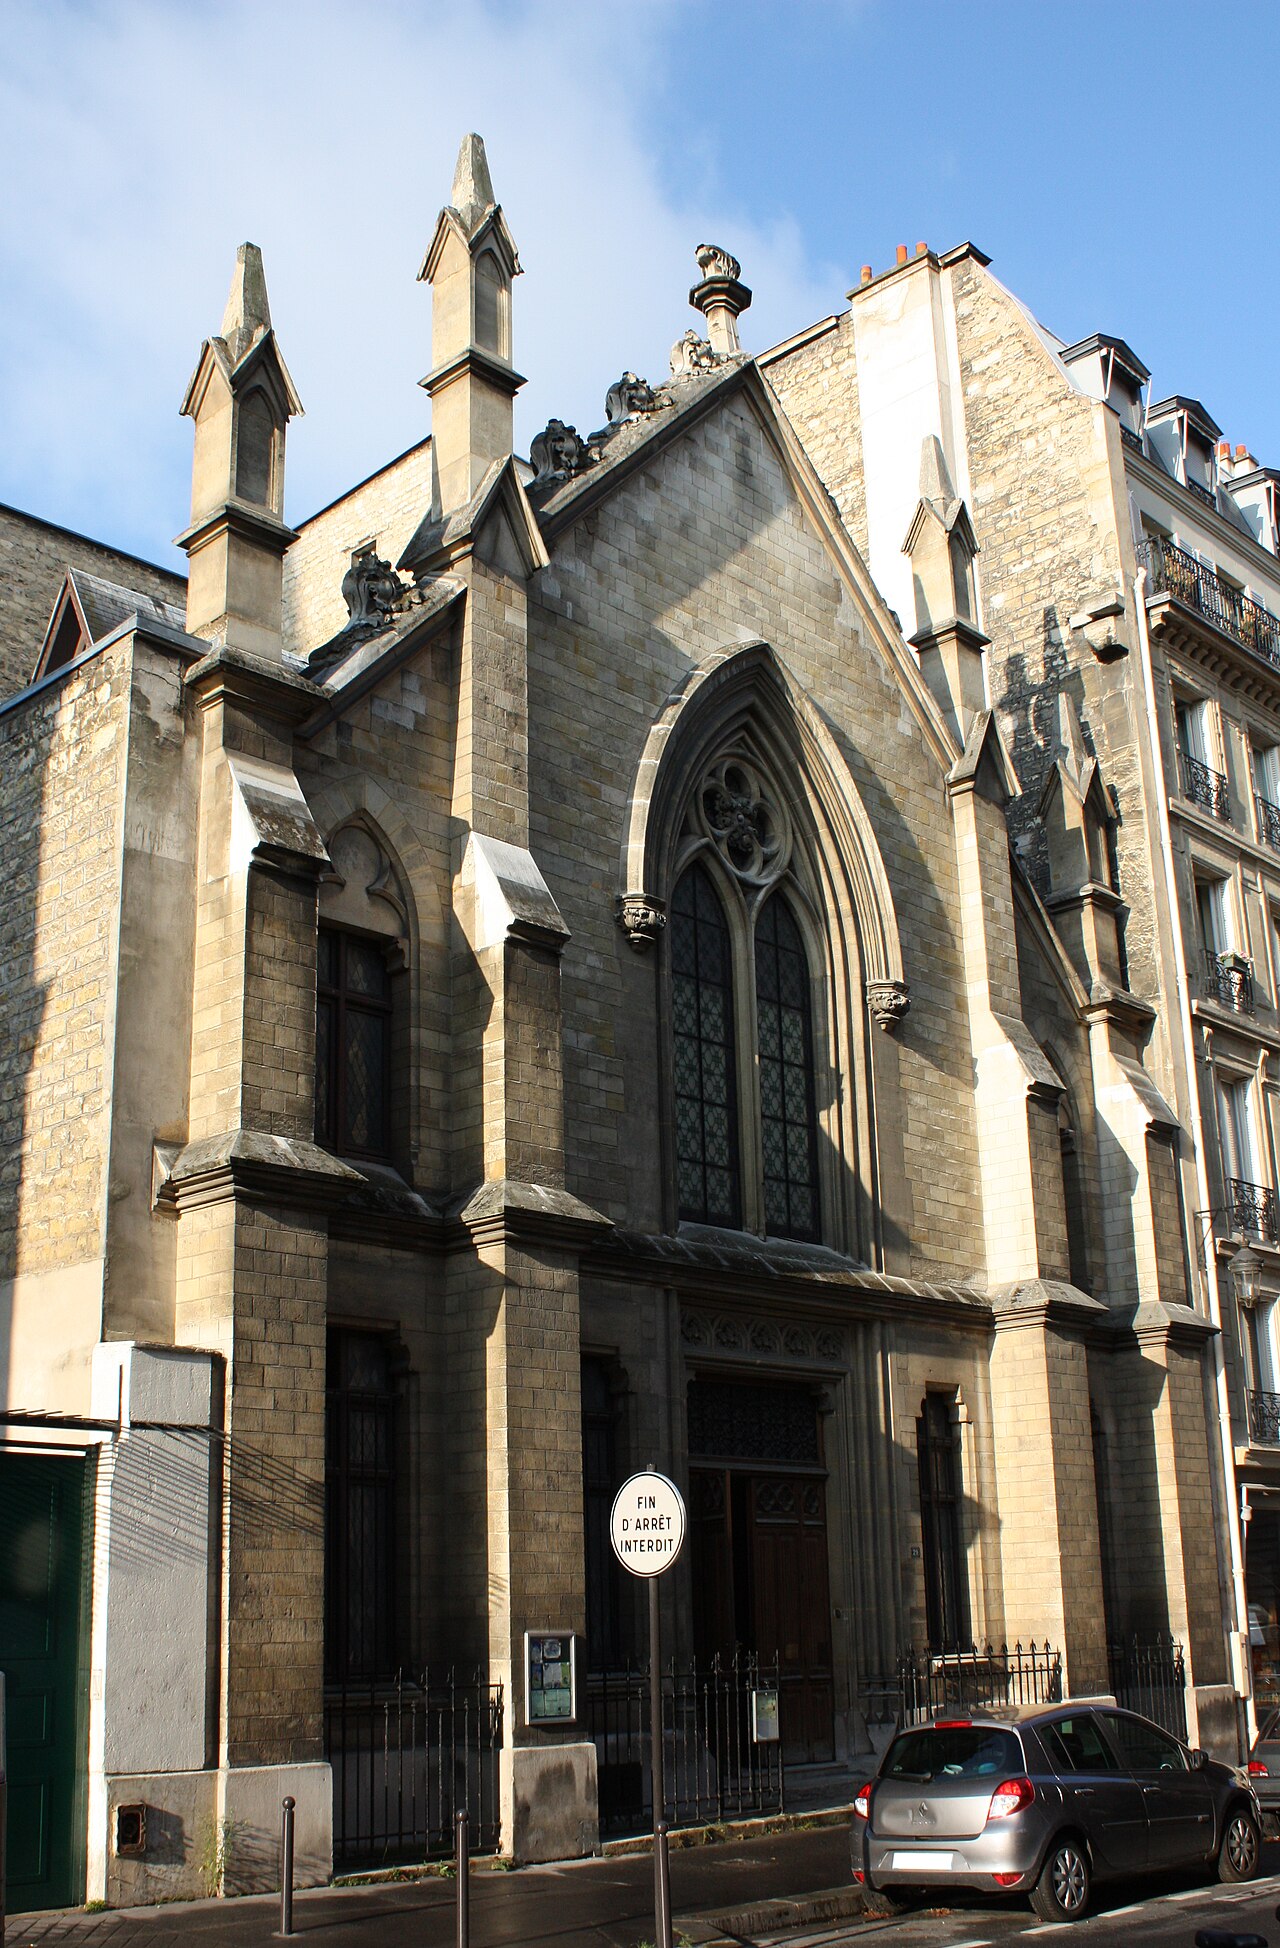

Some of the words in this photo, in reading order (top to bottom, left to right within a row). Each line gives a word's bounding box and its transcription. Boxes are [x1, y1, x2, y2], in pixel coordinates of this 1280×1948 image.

[637, 1496, 656, 1509] FIN
[622, 1514, 672, 1531] D'ARRÊT
[620, 1539, 674, 1553] INTERDIT
